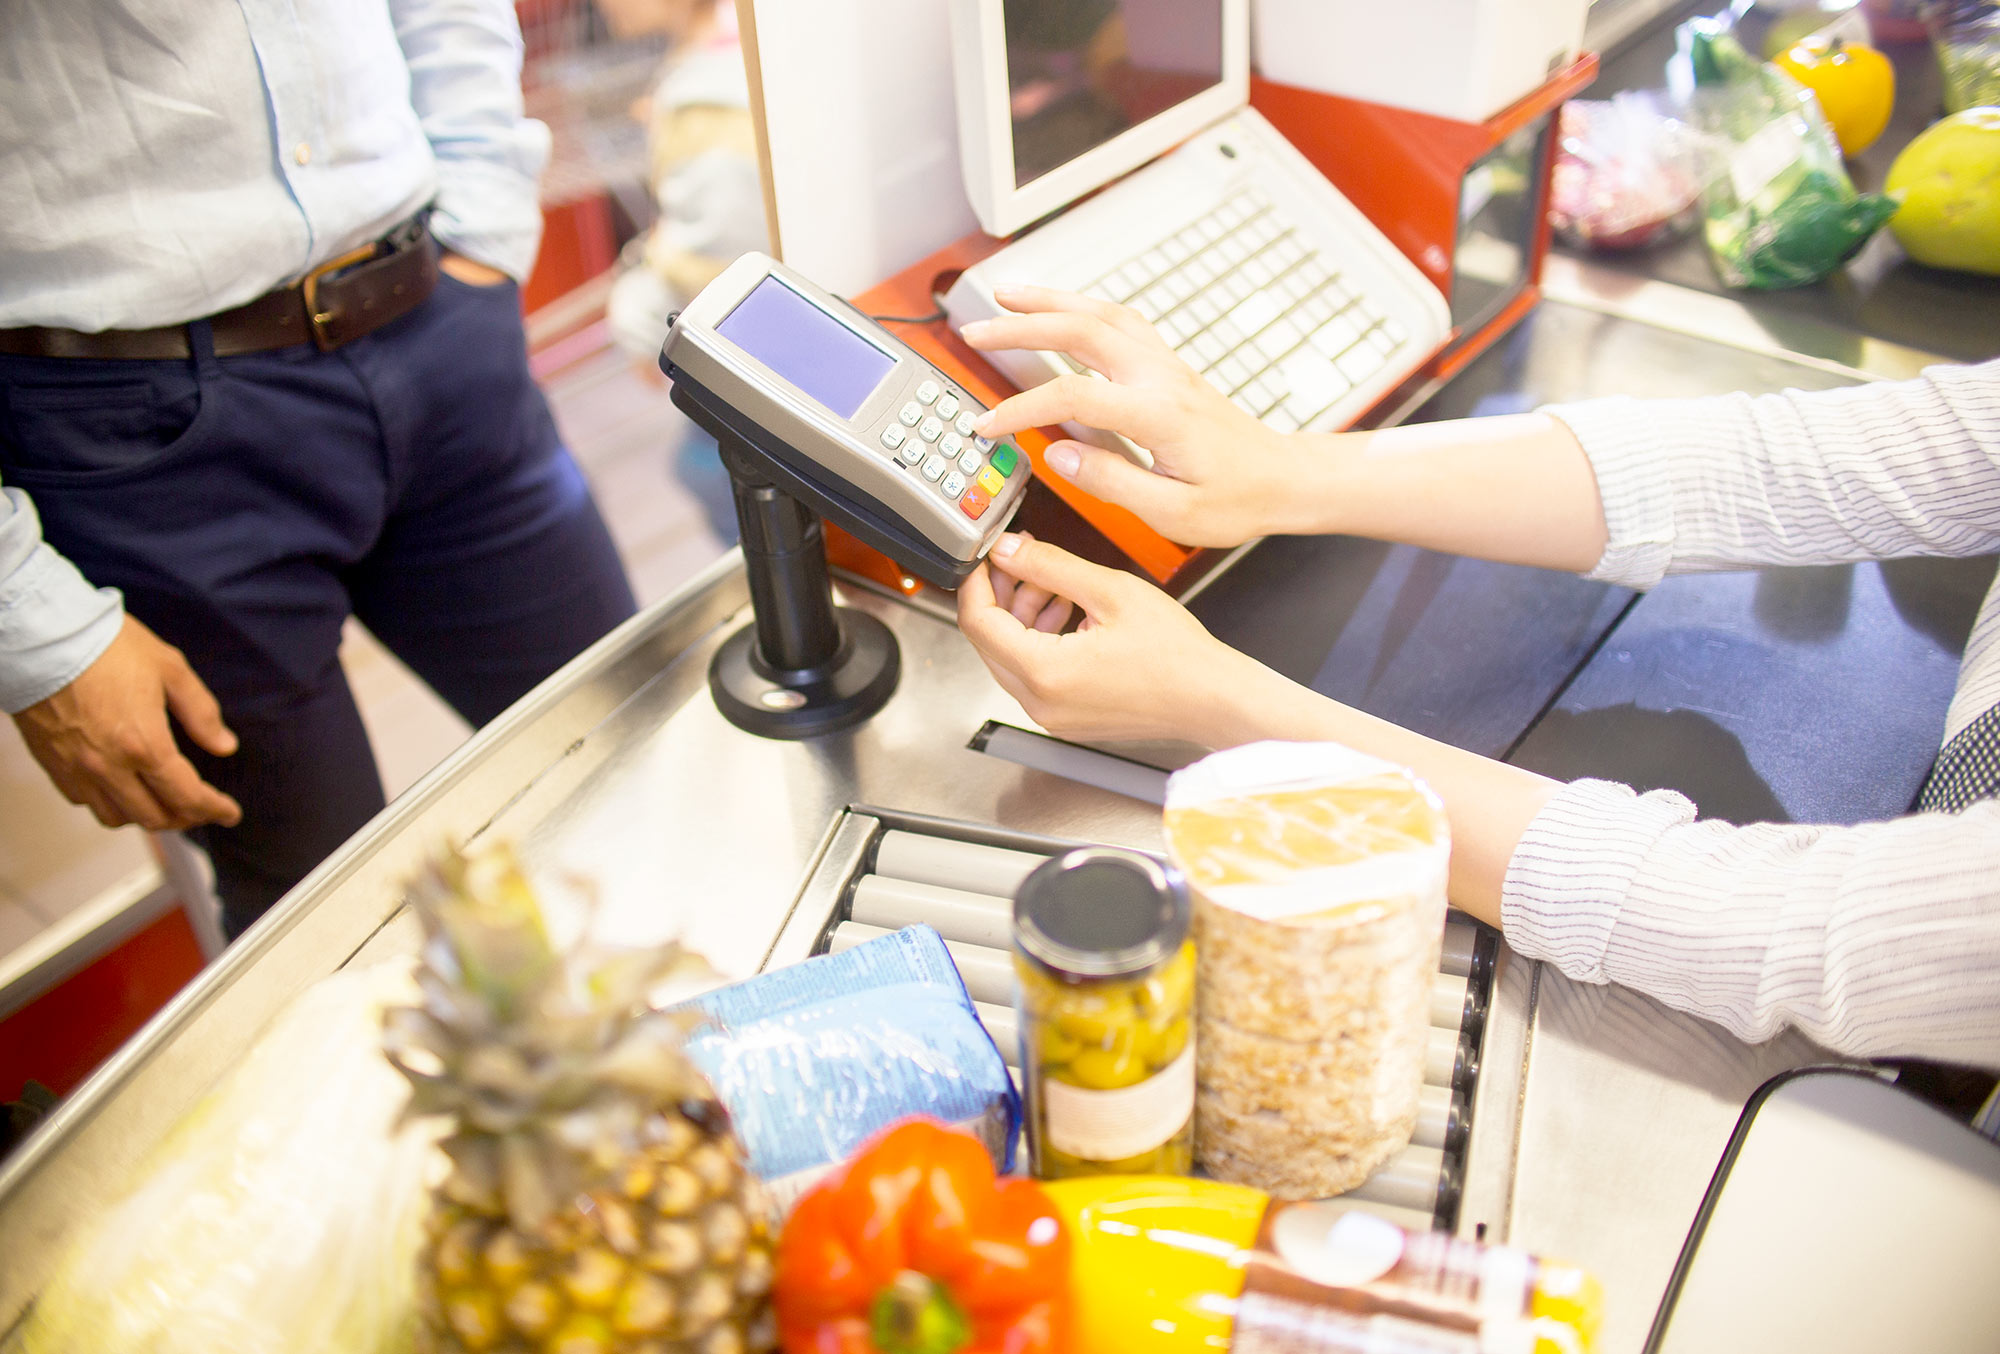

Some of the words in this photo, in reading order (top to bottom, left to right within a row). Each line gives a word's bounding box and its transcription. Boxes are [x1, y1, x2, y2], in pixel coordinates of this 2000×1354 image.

[903, 411, 914, 421] 2
[924, 426, 934, 436] 5
[887, 433, 897, 441] 1
[944, 443, 954, 453] 8
[907, 449, 917, 458] 4
[964, 459, 974, 469] 0
[927, 465, 937, 475] 7
